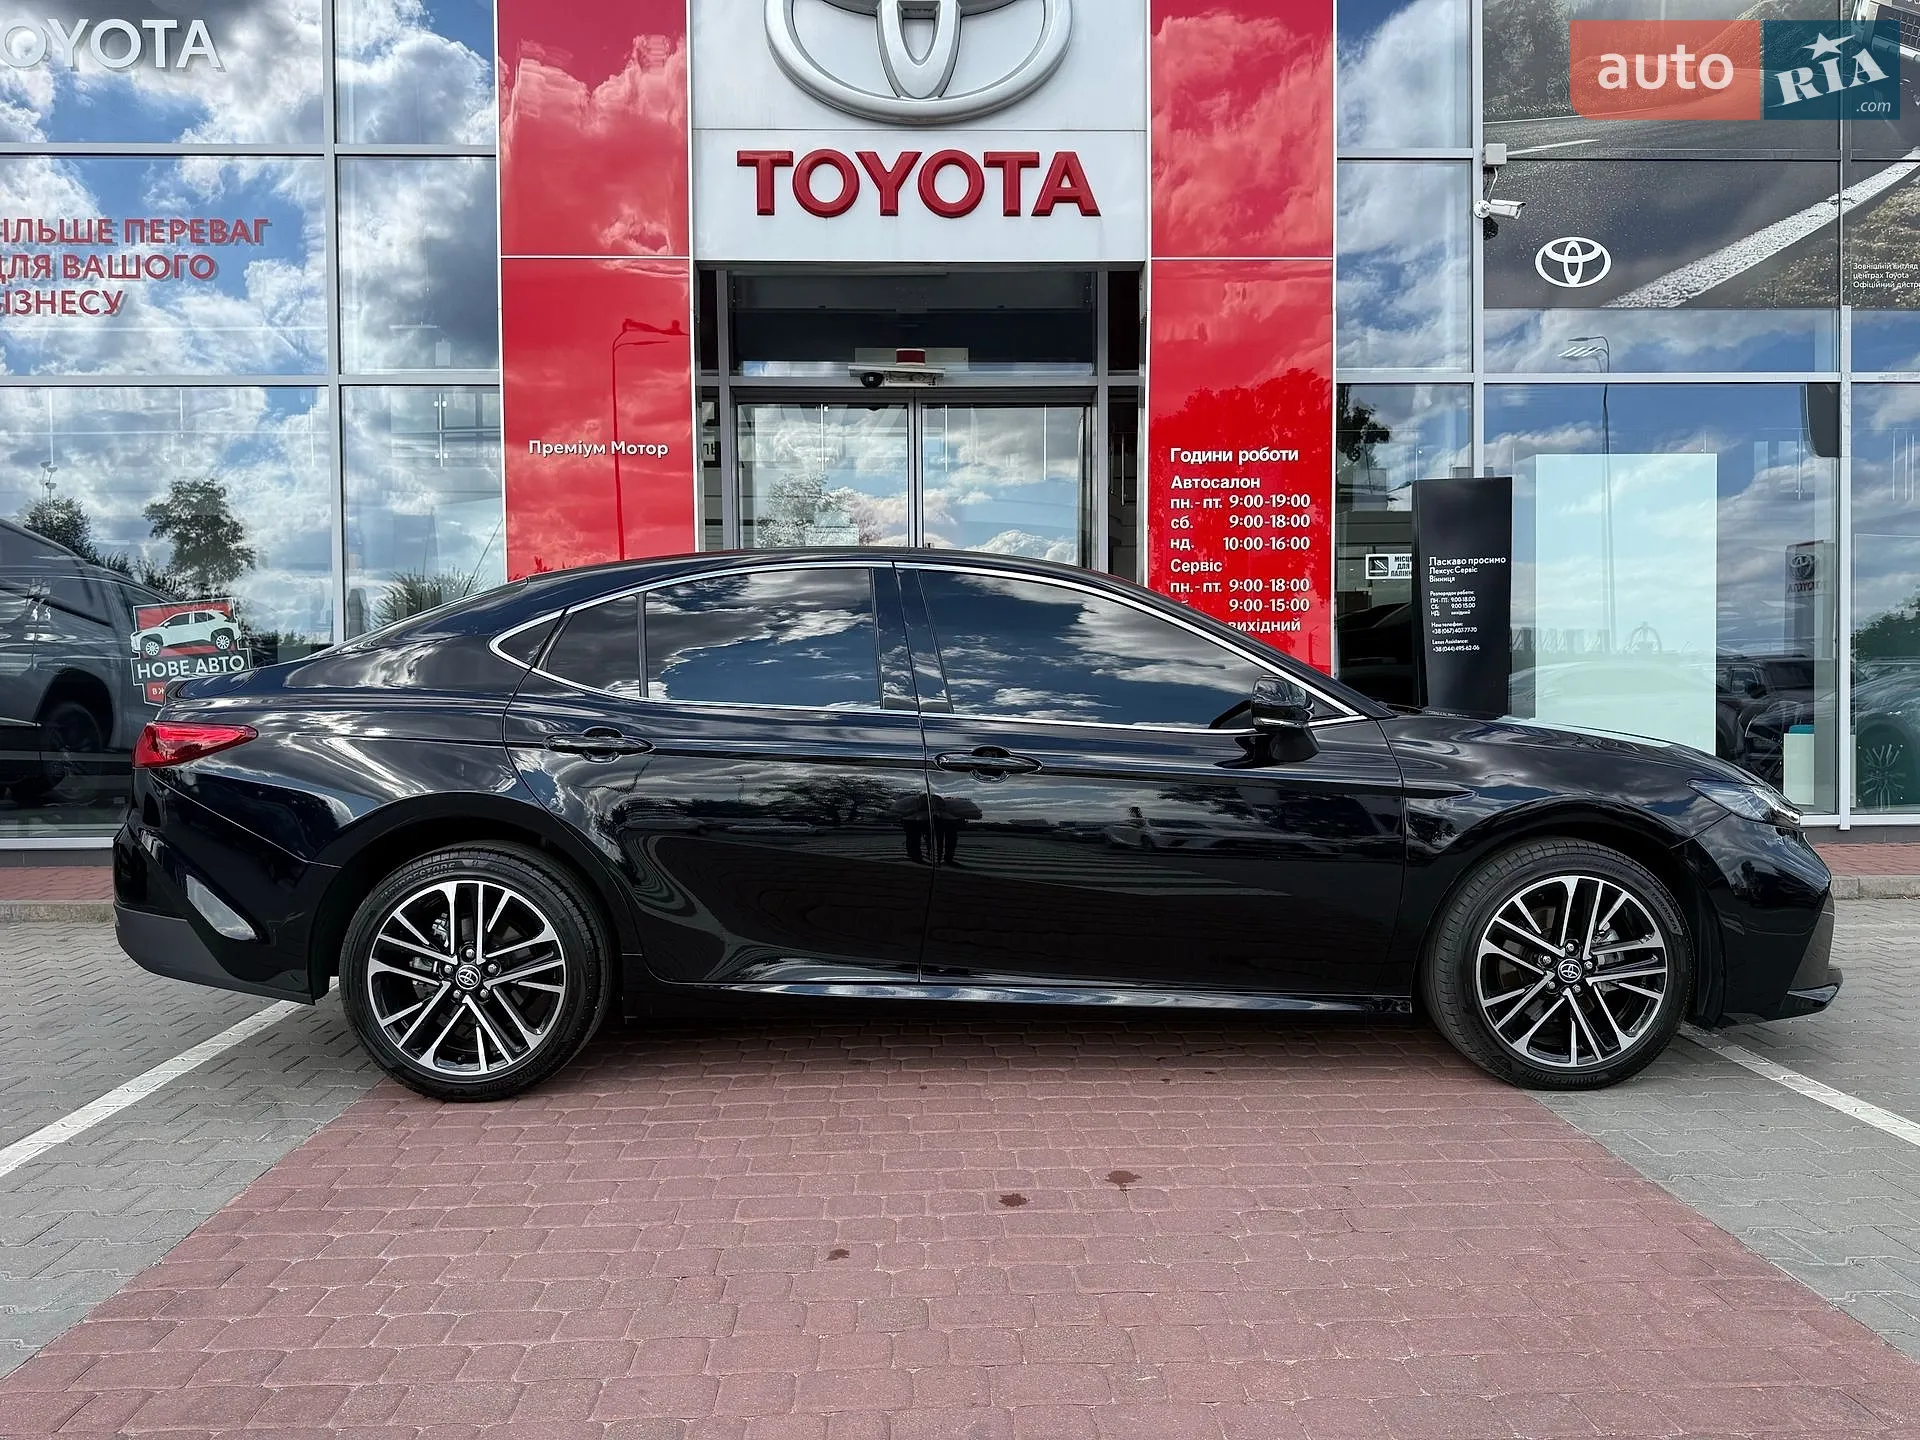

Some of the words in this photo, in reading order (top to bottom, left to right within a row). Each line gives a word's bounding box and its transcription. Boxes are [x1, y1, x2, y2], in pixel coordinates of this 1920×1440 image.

[736, 149, 1102, 218] TOYOTA
[124, 218, 270, 244] ПЕРЕВАГ
[62, 254, 216, 280] ВАШОГО
[1885, 271, 1910, 280] Toyota
[528, 440, 607, 458] Преміум
[611, 440, 670, 458] Мотор
[1170, 447, 1233, 465] Години
[1238, 446, 1299, 466] роботи
[1170, 475, 1261, 489] Автосалон
[1228, 494, 1311, 508] 9:00-19:00
[1170, 516, 1194, 529] сб.
[1228, 514, 1311, 529] 9:00-18:00
[1170, 538, 1195, 551] нд.
[1222, 536, 1311, 551] 10:00-16:00
[1170, 558, 1223, 575] Сервіс
[1429, 556, 1467, 566] Ласкаво
[1468, 557, 1507, 566] просимо
[1429, 567, 1454, 575] Лексус
[1454, 566, 1478, 575] Сервіс
[1228, 578, 1310, 593] 9:00-18:00
[1429, 575, 1456, 583] Вінниця
[1228, 599, 1310, 612] 9:00-15:00
[137, 660, 190, 679] НОВЕ
[195, 655, 245, 673] АВТО
